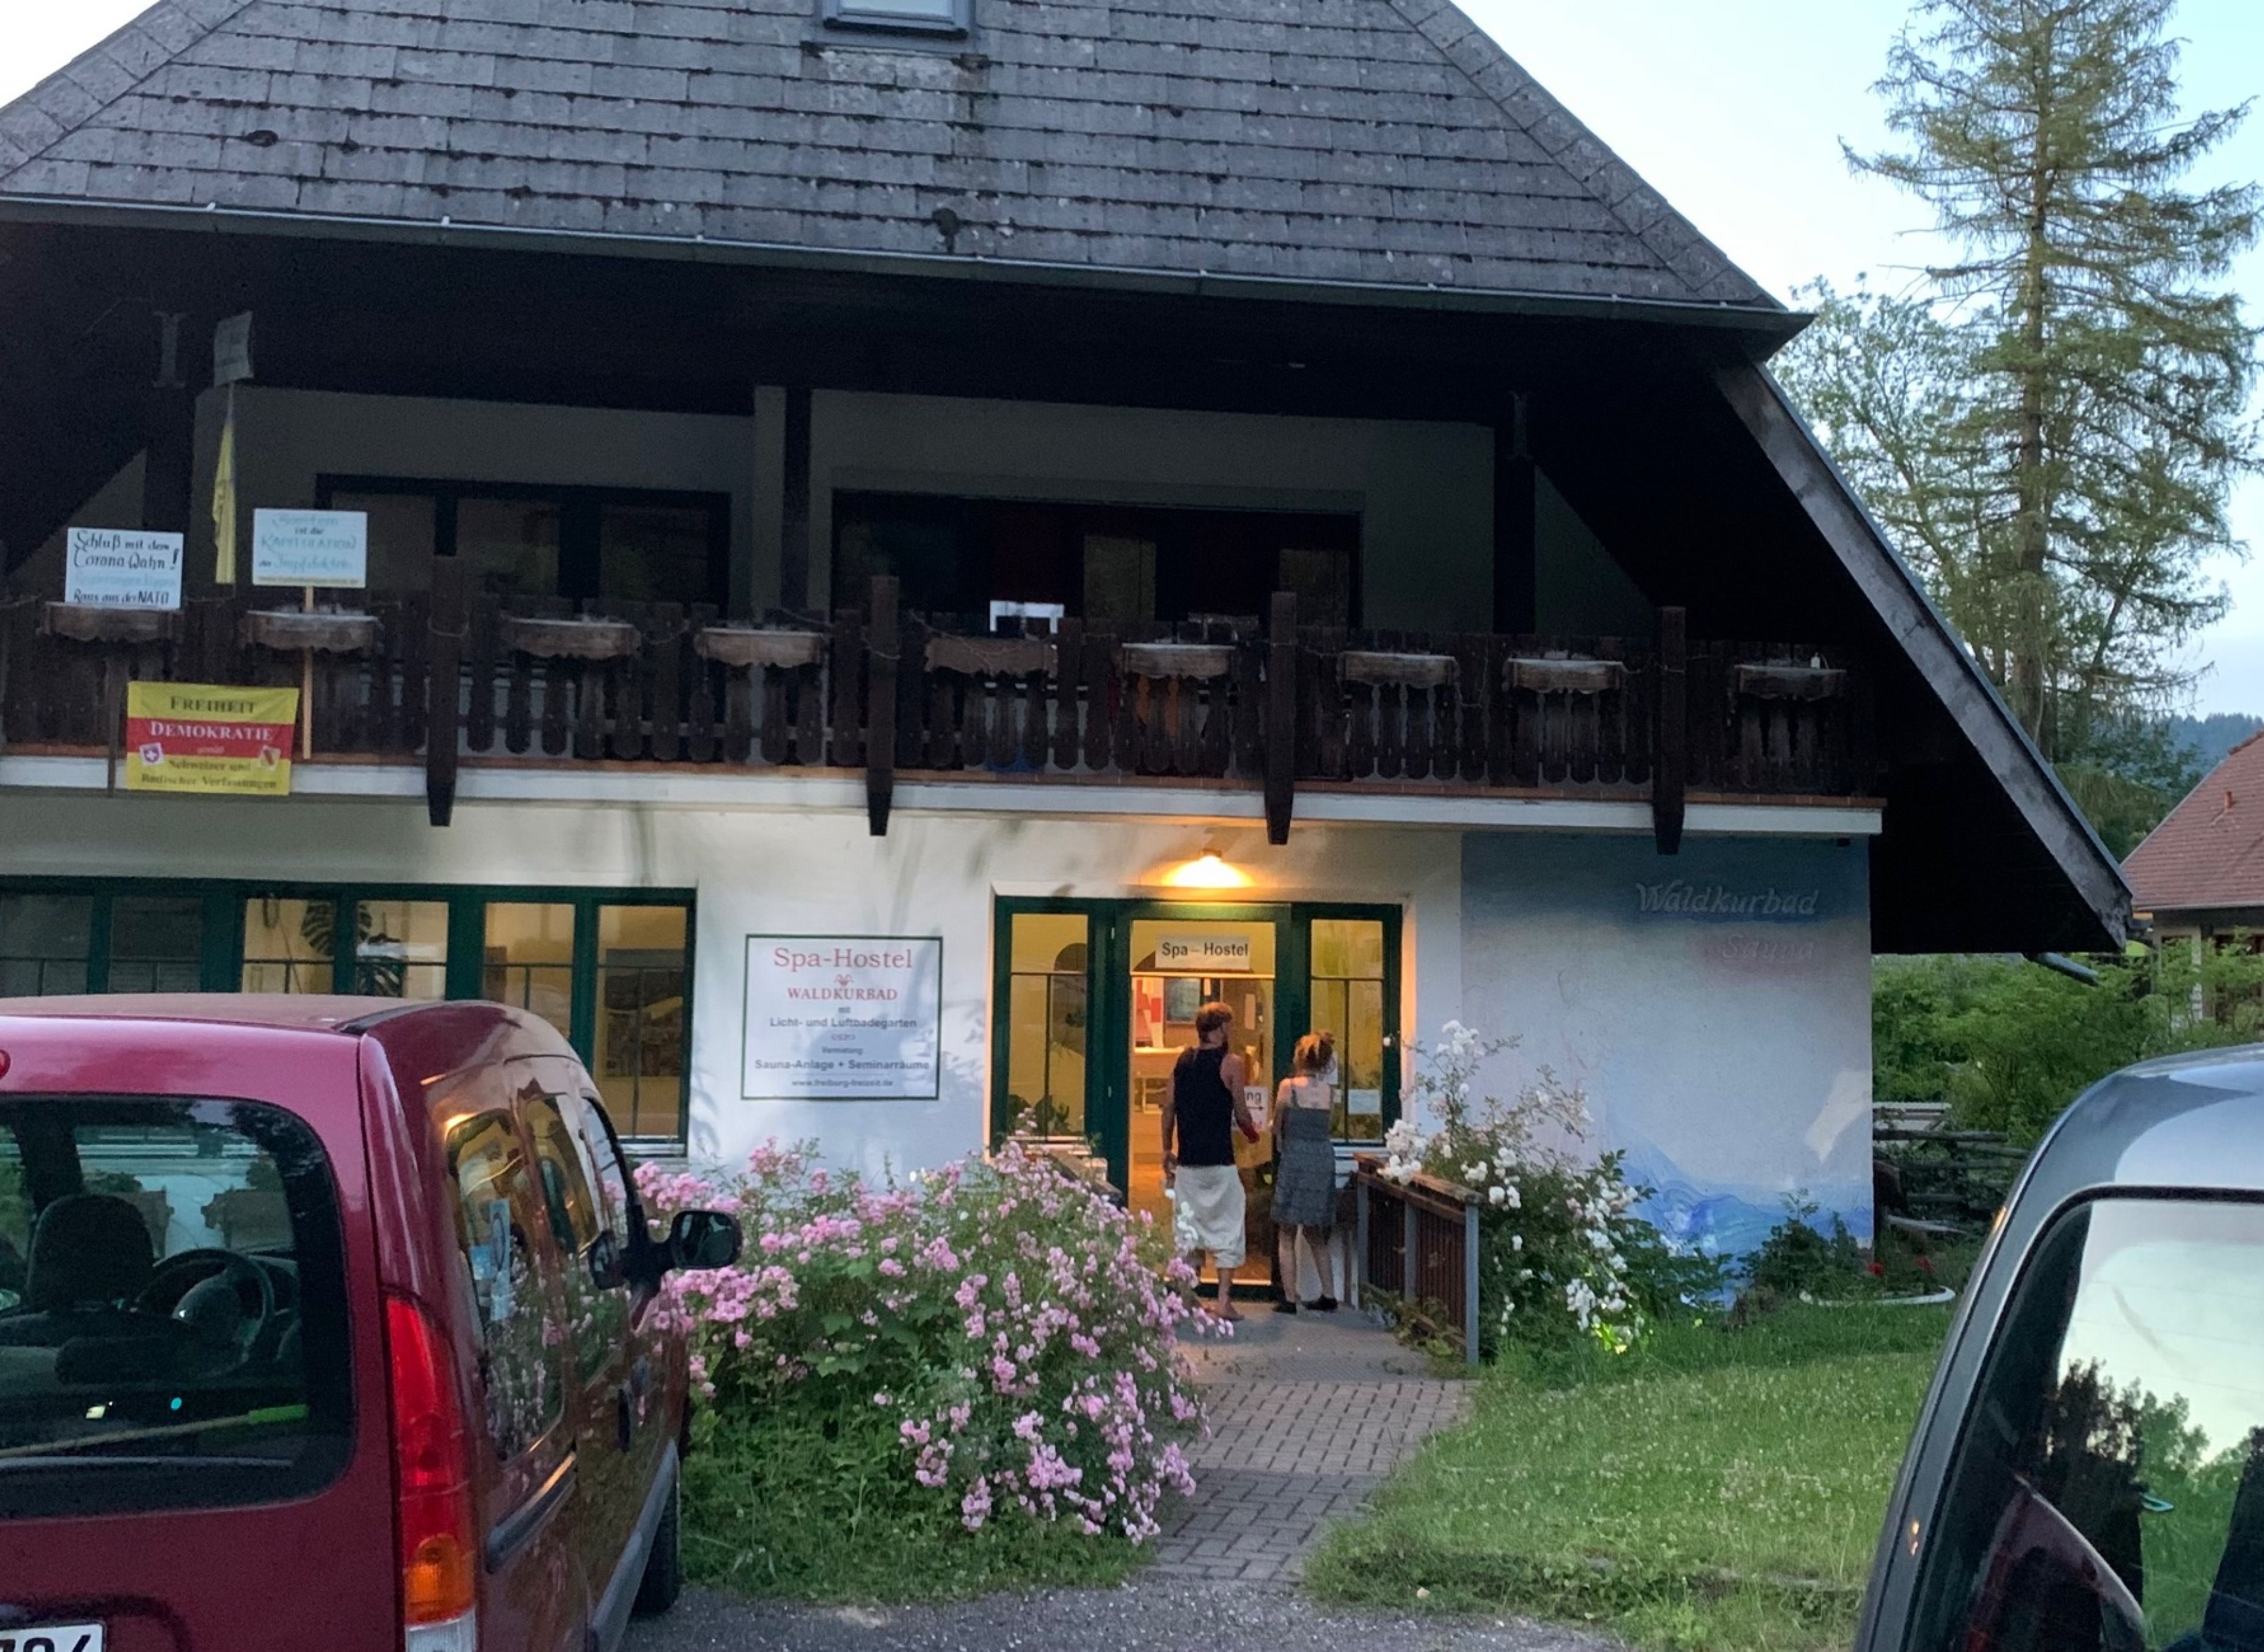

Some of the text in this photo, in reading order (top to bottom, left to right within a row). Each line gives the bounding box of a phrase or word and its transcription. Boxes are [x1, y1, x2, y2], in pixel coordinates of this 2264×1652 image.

[75, 530, 170, 552] Schluß mit dem
[73, 545, 125, 568] Corona
[138, 590, 169, 604] NATO
[171, 696, 256, 713] FREIHEIT
[151, 721, 273, 740] DEMOKRATIE
[1636, 879, 1820, 915] Waldkurbad
[1204, 941, 1249, 956] Hostel
[1722, 933, 1815, 961] Sauna
[773, 947, 912, 972] Spa-Hostel
[788, 988, 898, 1000] WALDKURBAD
[770, 1018, 917, 1029] Licht- und Luftbadegarten
[754, 1059, 929, 1071] Sauna-Anlage Seminarräume
